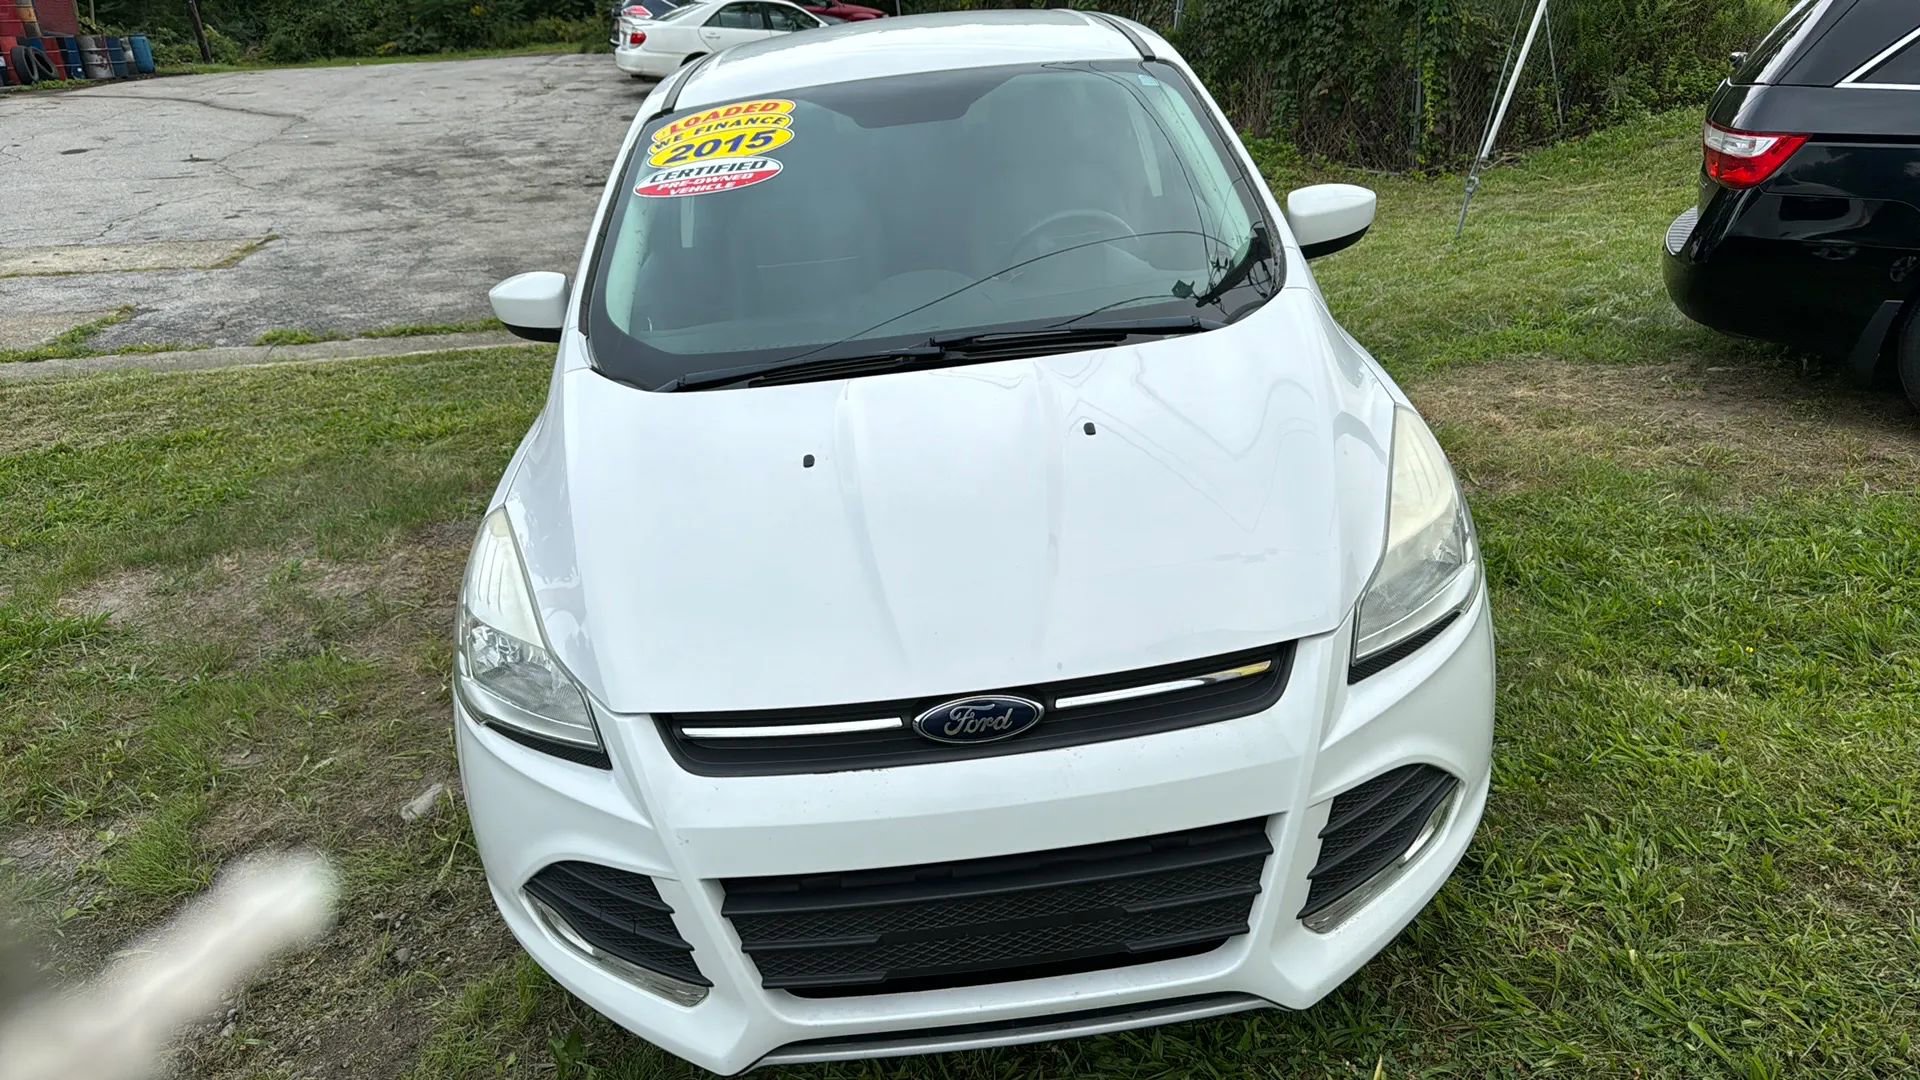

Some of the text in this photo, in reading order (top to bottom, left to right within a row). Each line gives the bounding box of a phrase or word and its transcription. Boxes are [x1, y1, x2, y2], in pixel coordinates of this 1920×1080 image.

[655, 115, 787, 150] WE FINANCE
[670, 102, 781, 135] LOADED
[662, 129, 777, 165] 2015
[650, 159, 768, 183] CERTIFIED
[657, 172, 755, 191] PRE-OWNED
[669, 181, 736, 195] VEHICLE
[944, 703, 1013, 735] Ford
